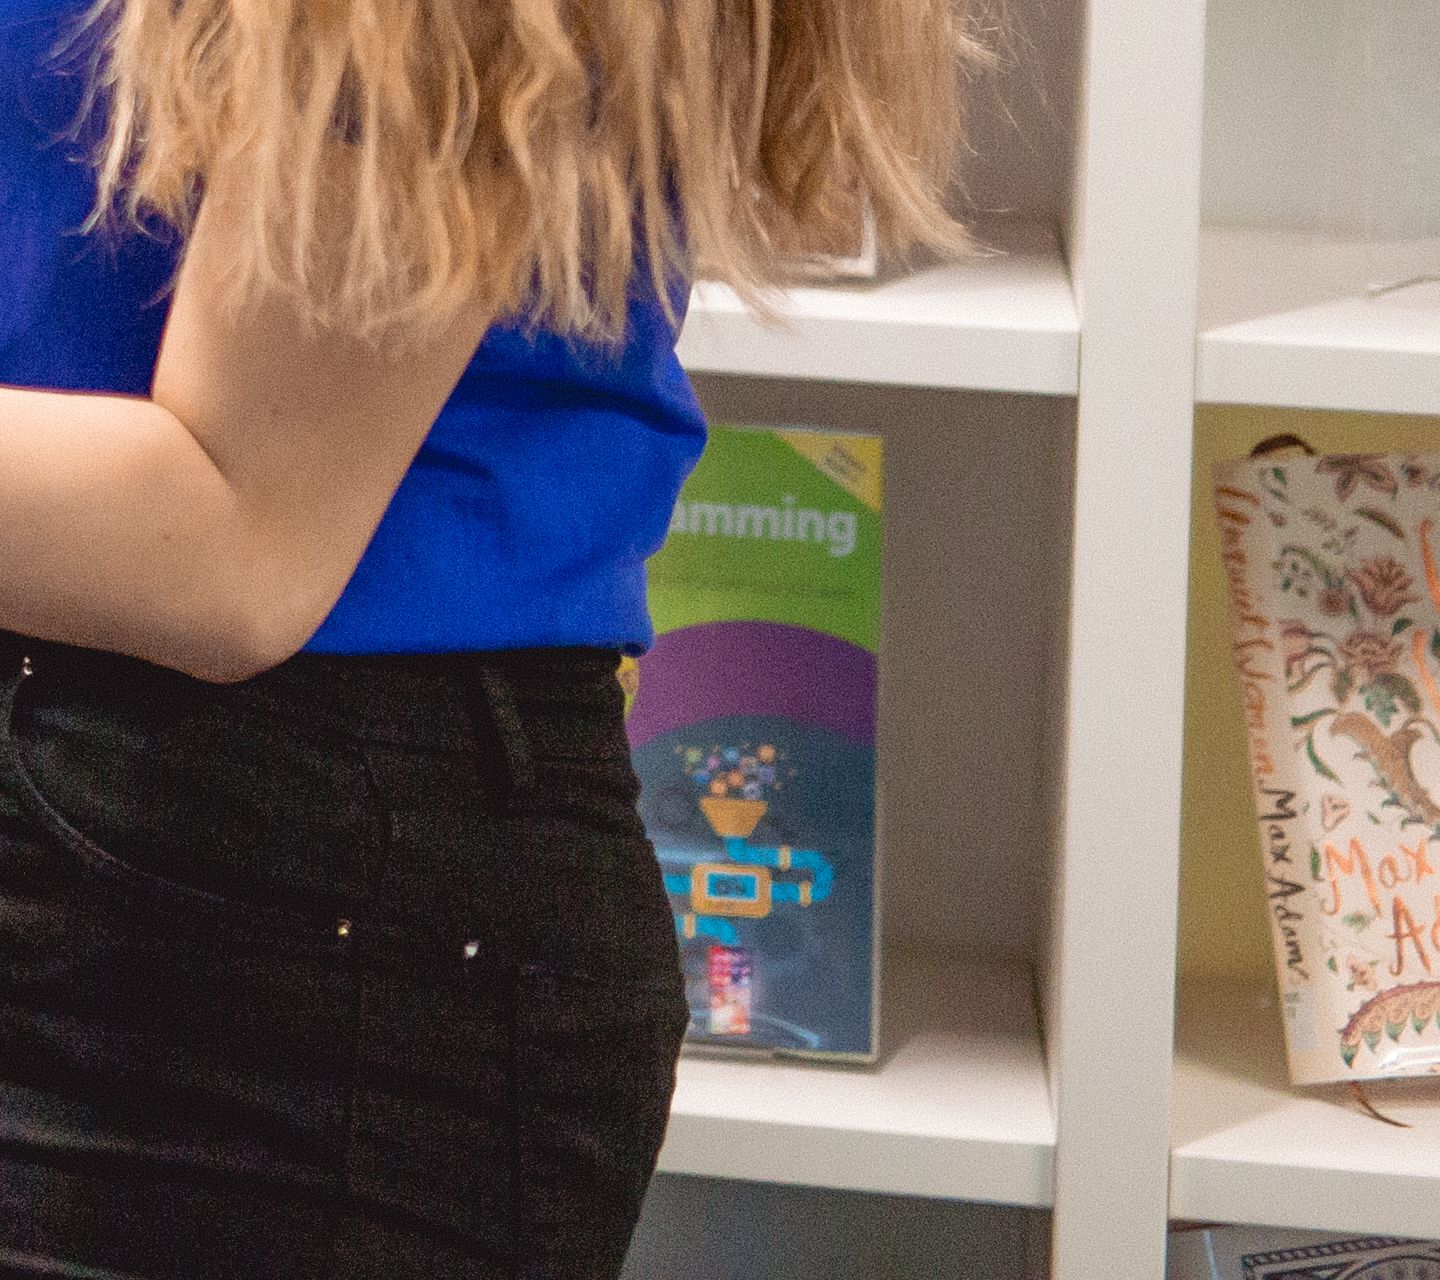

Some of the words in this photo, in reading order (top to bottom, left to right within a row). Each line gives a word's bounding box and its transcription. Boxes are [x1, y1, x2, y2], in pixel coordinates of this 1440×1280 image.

[1259, 788, 1298, 864] Max
[1320, 835, 1436, 918] Max
[1265, 870, 1310, 981] Adams
